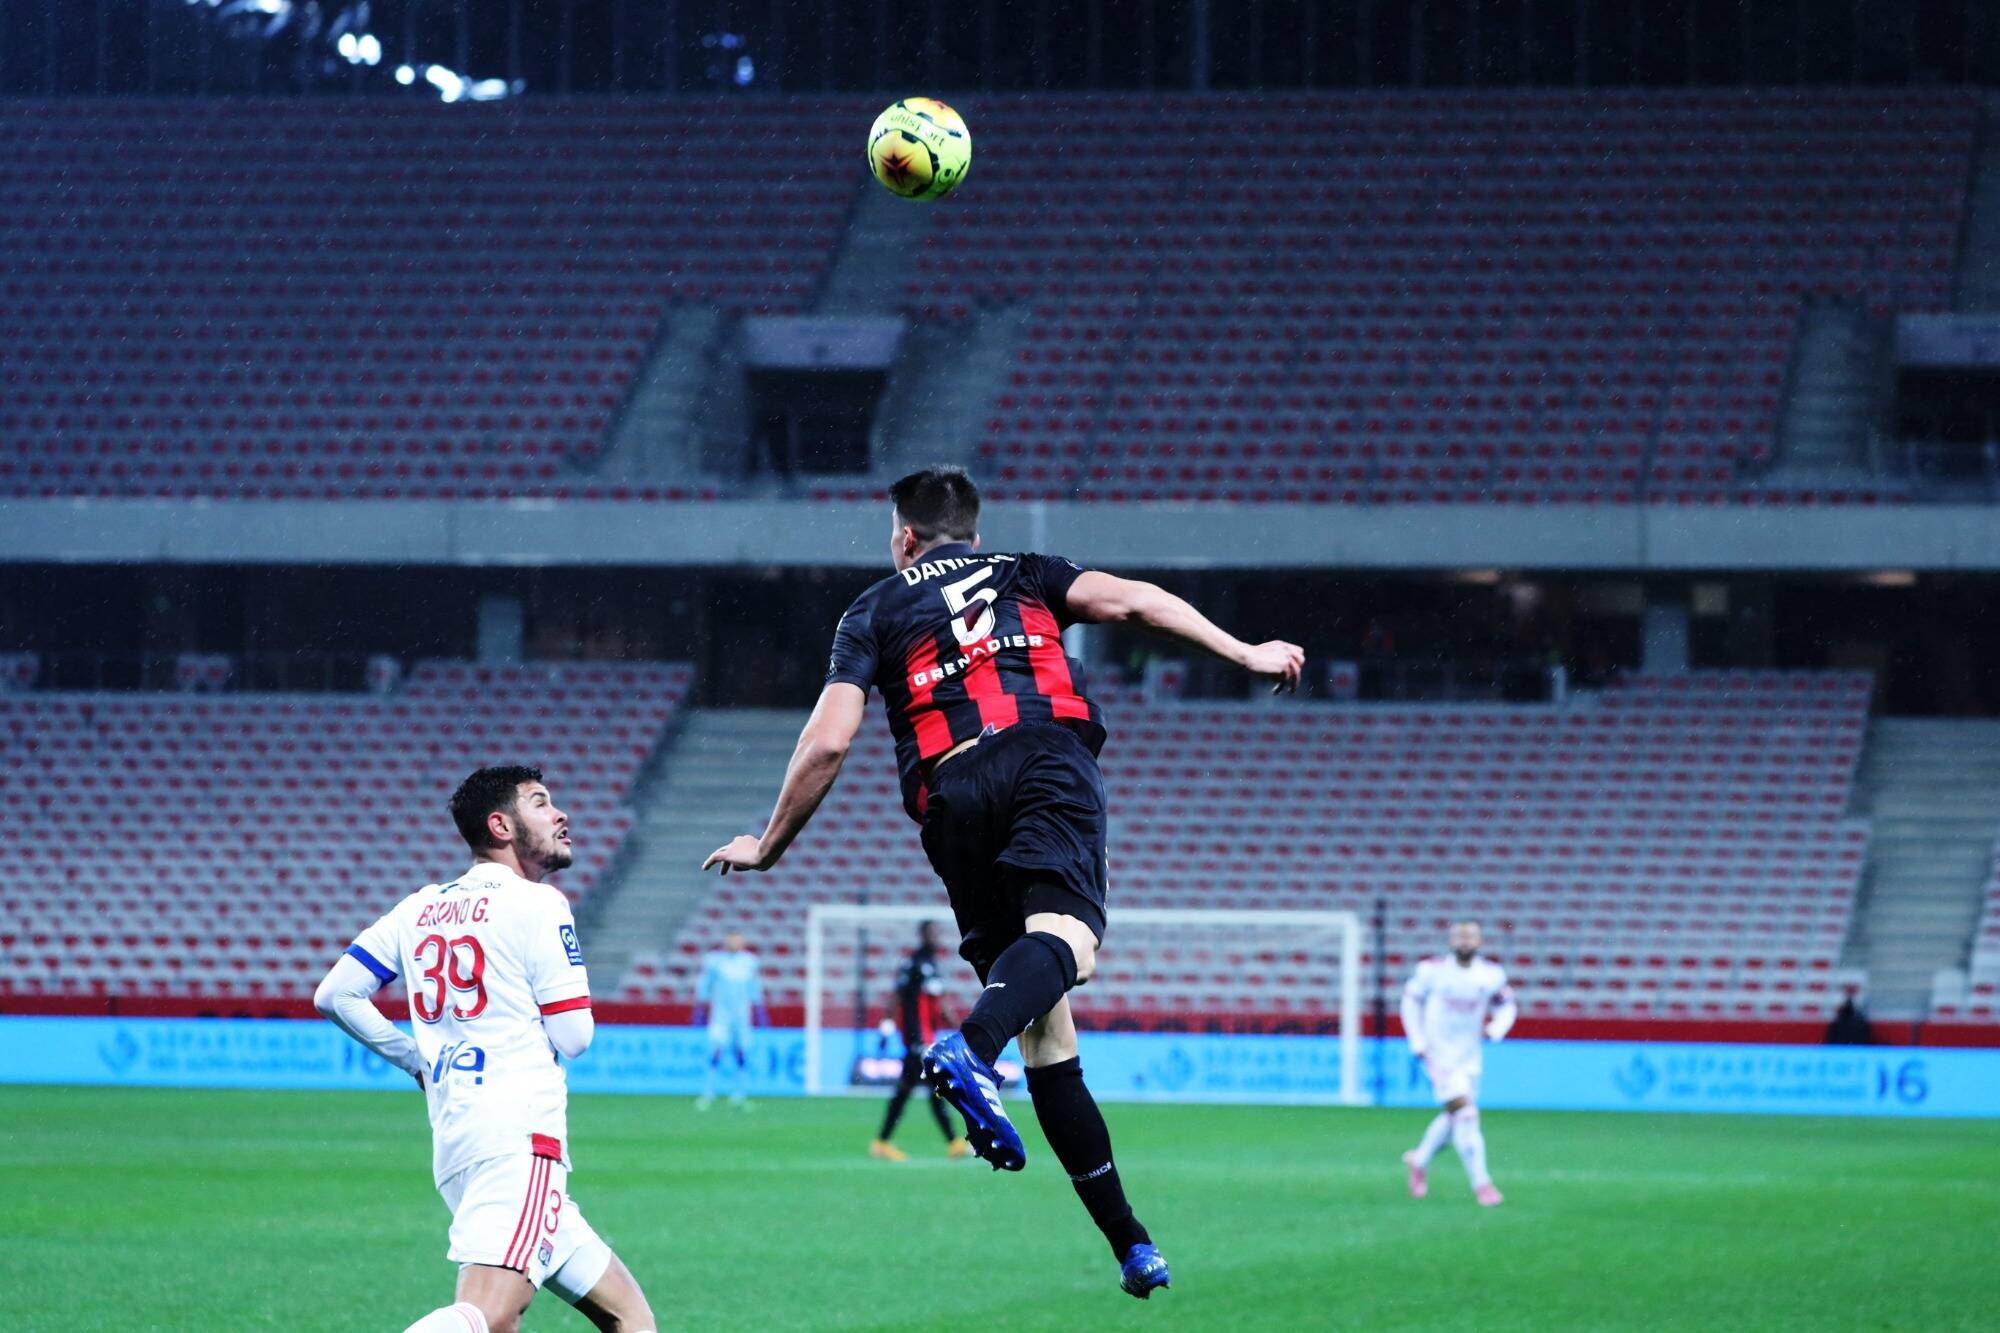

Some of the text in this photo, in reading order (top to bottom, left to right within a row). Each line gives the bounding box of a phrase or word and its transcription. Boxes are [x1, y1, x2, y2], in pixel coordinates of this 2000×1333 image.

[941, 565, 998, 646] 5
[913, 635, 1043, 687] GRENADIER
[413, 934, 488, 1024] 39
